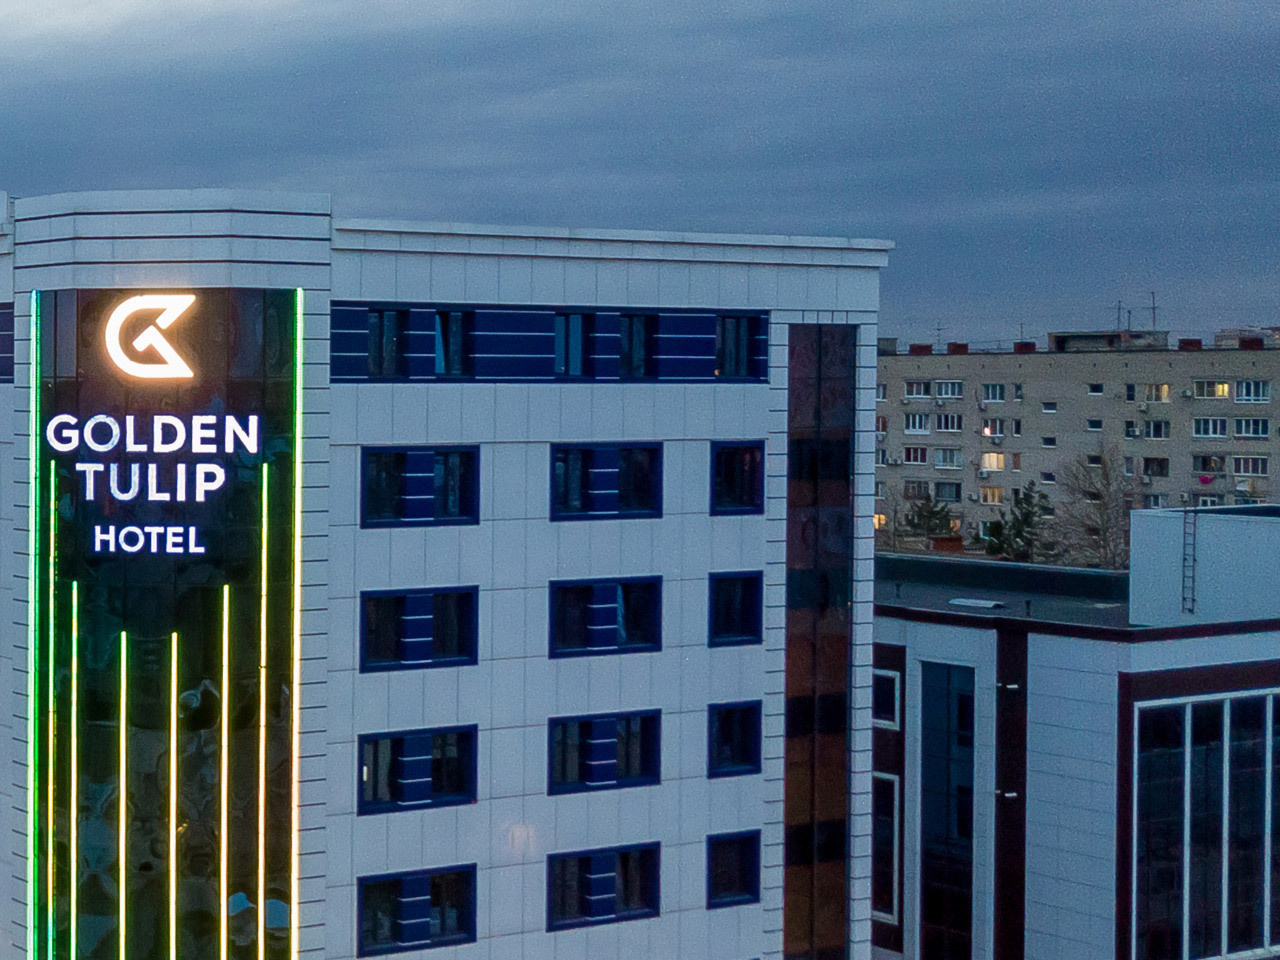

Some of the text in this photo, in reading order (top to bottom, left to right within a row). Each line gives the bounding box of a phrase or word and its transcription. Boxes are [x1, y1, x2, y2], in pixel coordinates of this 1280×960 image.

[46, 413, 259, 453] GOLDEN
[75, 462, 226, 502] TULIP
[94, 525, 206, 554] HOTEL
